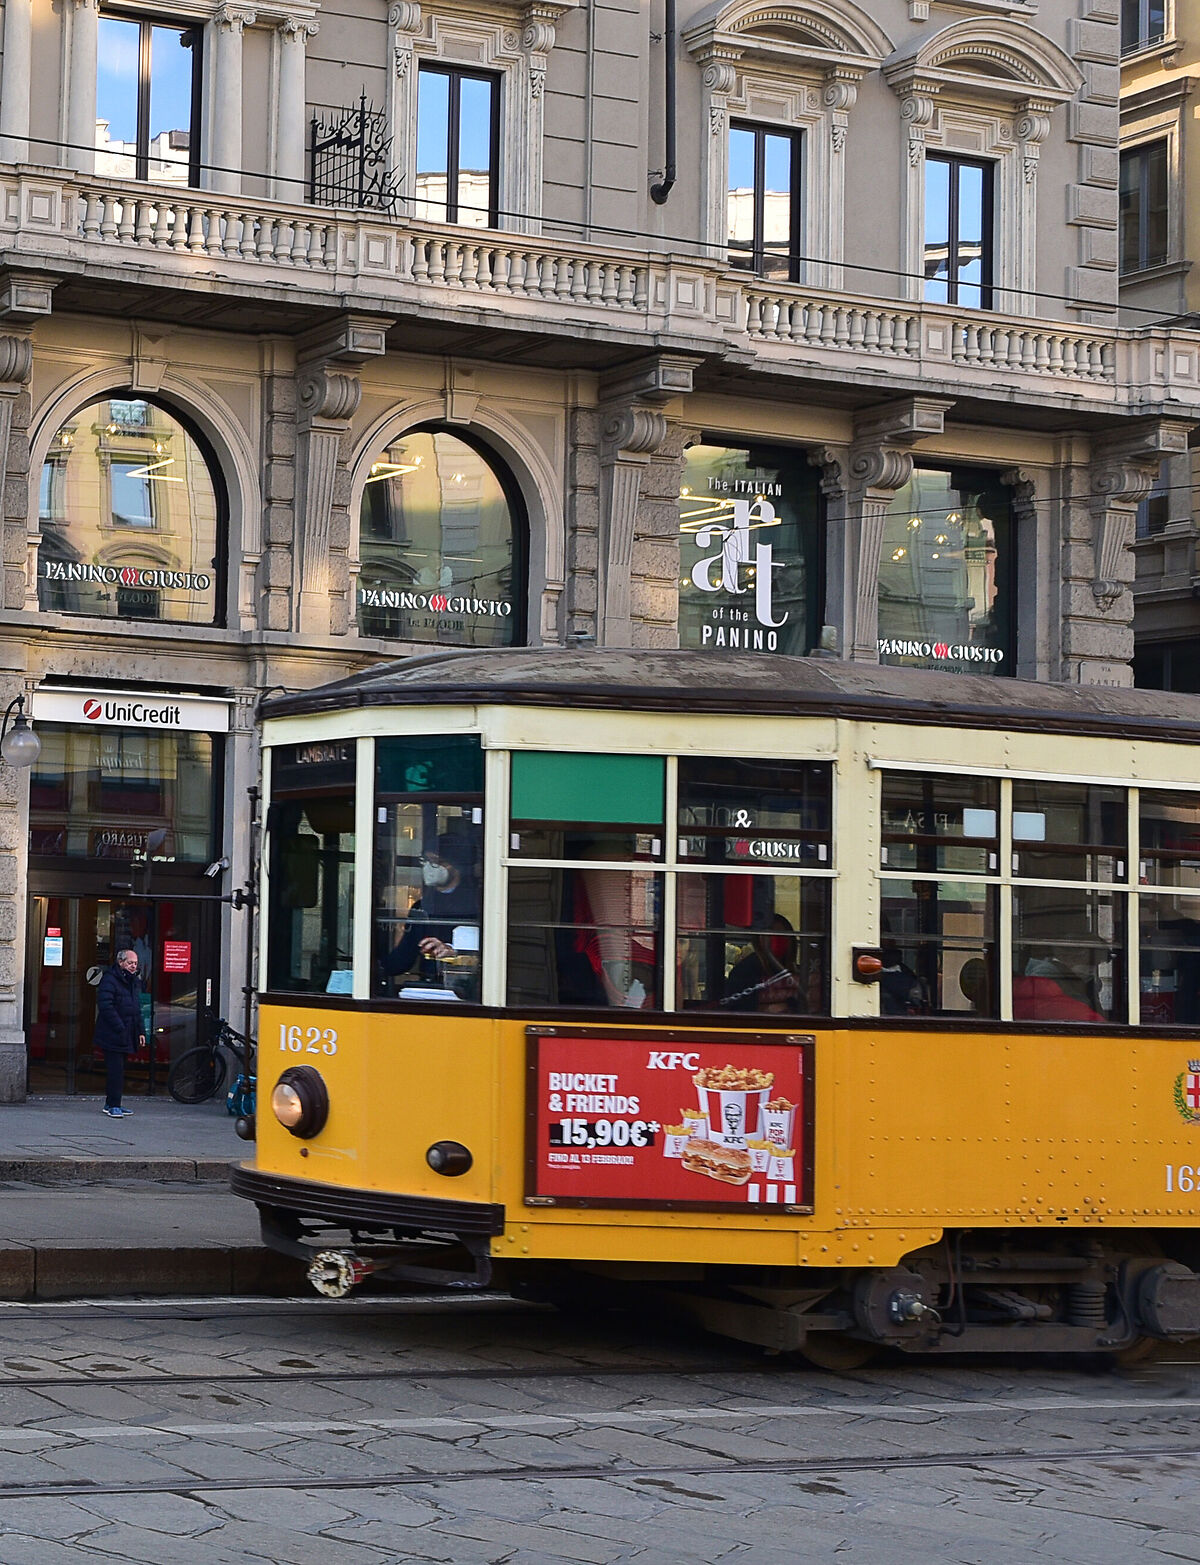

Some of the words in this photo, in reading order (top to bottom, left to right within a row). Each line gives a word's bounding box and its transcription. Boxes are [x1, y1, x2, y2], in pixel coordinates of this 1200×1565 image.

[708, 476, 728, 491] The
[734, 479, 782, 496] ITALIAN
[45, 561, 117, 584] PANINO
[139, 571, 210, 591] GIUSTO
[361, 588, 427, 609] PANINO
[447, 597, 512, 617] GIUSTO
[712, 607, 724, 619] of
[729, 608, 749, 621] the
[702, 625, 778, 651] PANINO
[877, 638, 931, 657] PANINO
[948, 644, 1004, 663] GIUSTO
[105, 702, 180, 724] UniCredit
[734, 808, 752, 829] &
[279, 1024, 338, 1056] 1623
[647, 1051, 700, 1071] KFC
[549, 1072, 618, 1093] BUCKET
[549, 1094, 563, 1112] &
[566, 1096, 640, 1115] FRIENDS
[723, 1136, 744, 1144] KFC
[1165, 1164, 1200, 1192] 16
